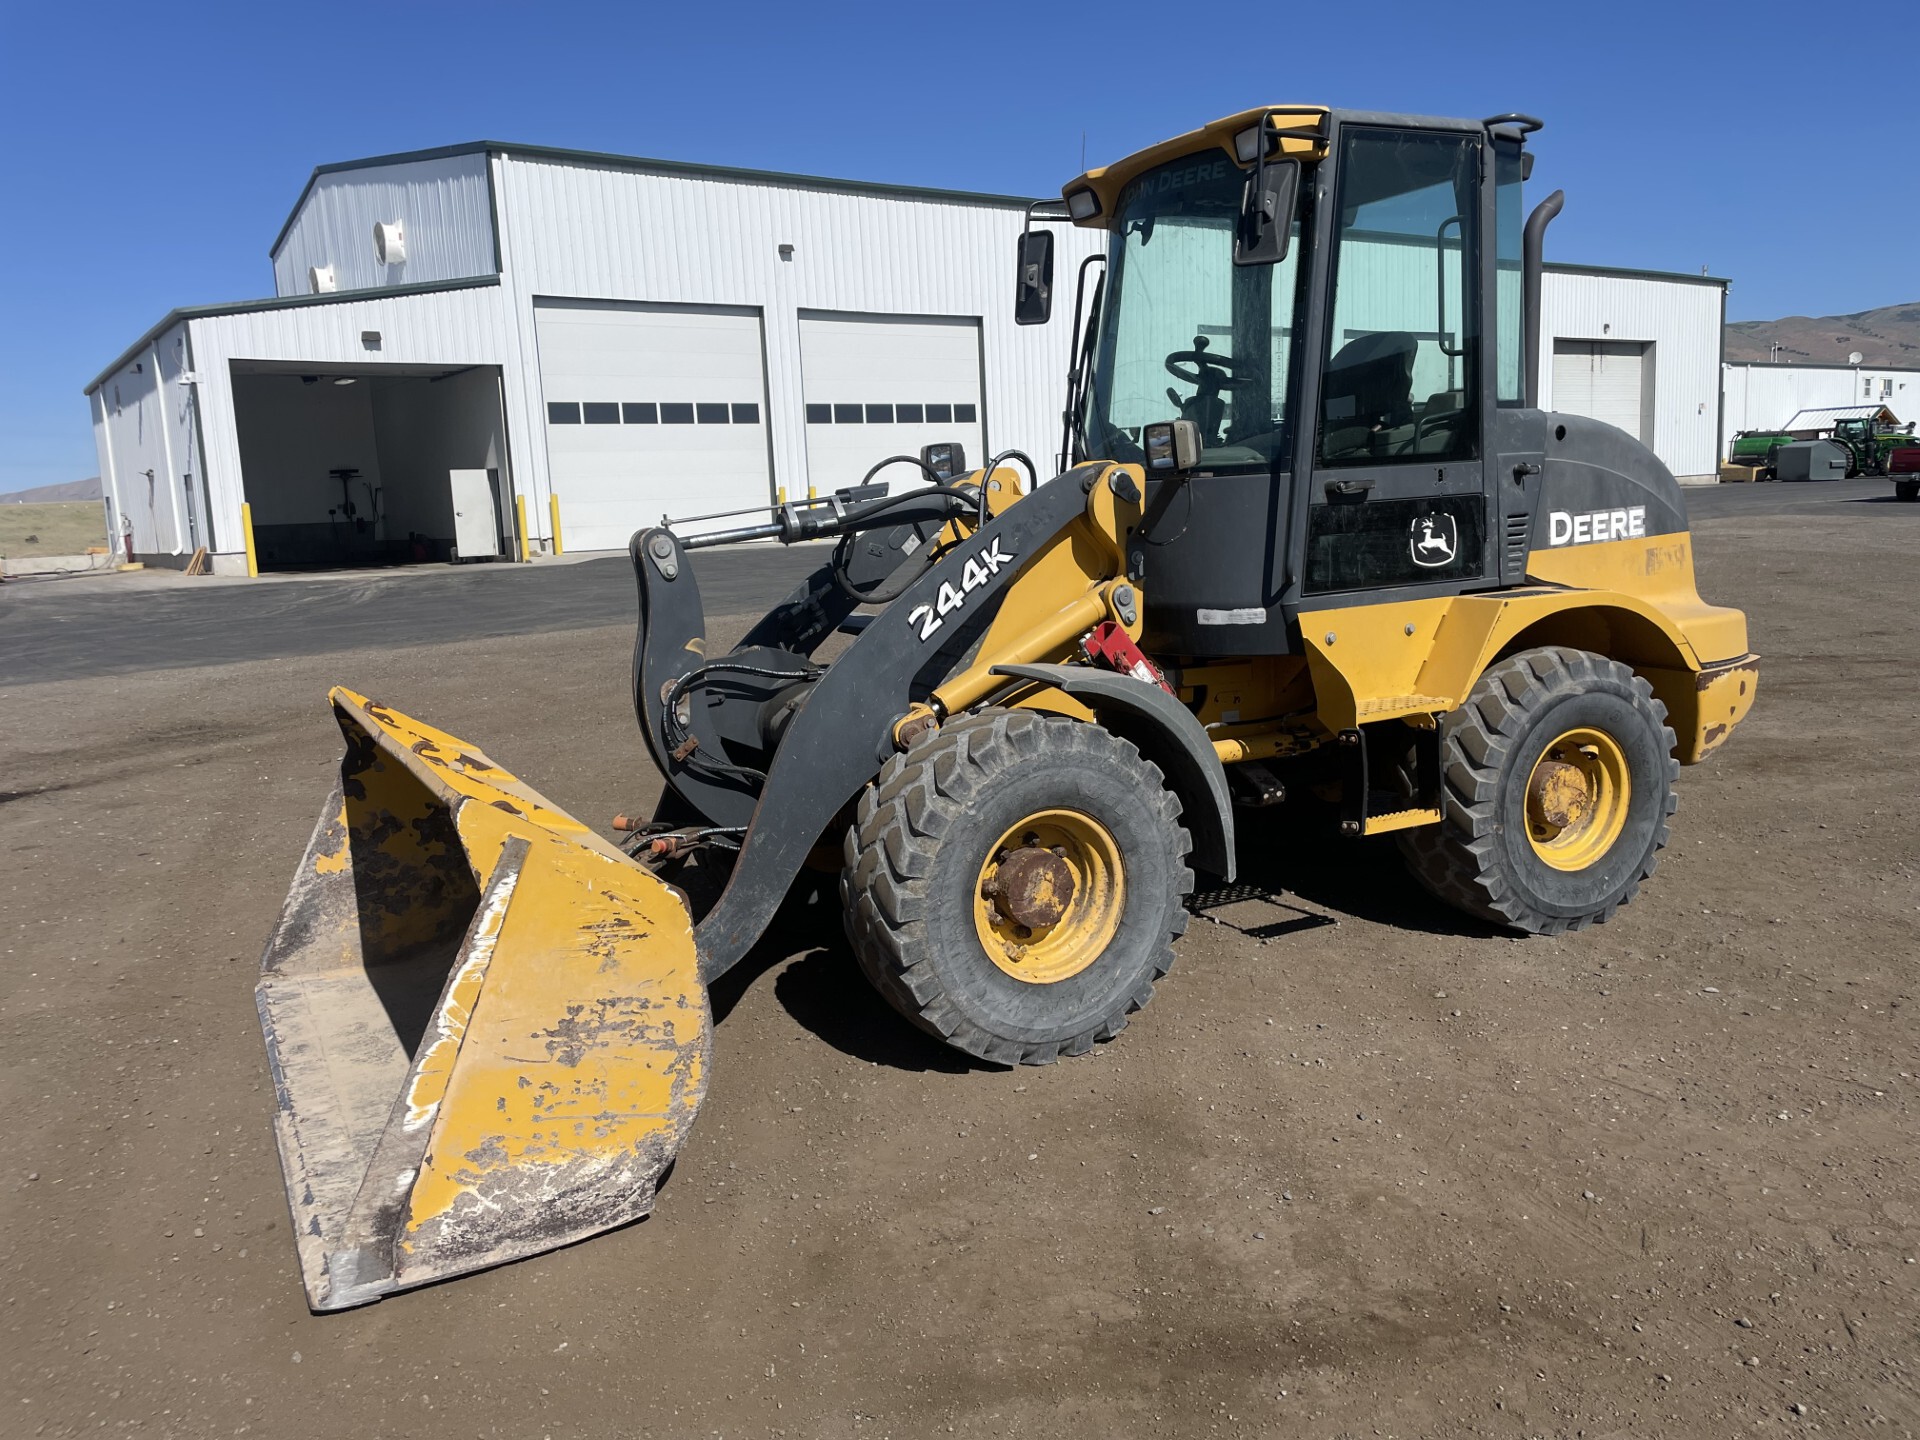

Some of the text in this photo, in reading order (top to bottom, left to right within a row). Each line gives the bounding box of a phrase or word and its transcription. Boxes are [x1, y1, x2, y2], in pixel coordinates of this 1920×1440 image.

[1158, 160, 1228, 193] DEERE
[1549, 507, 1645, 546] DEERE
[907, 535, 1016, 642] 244K
